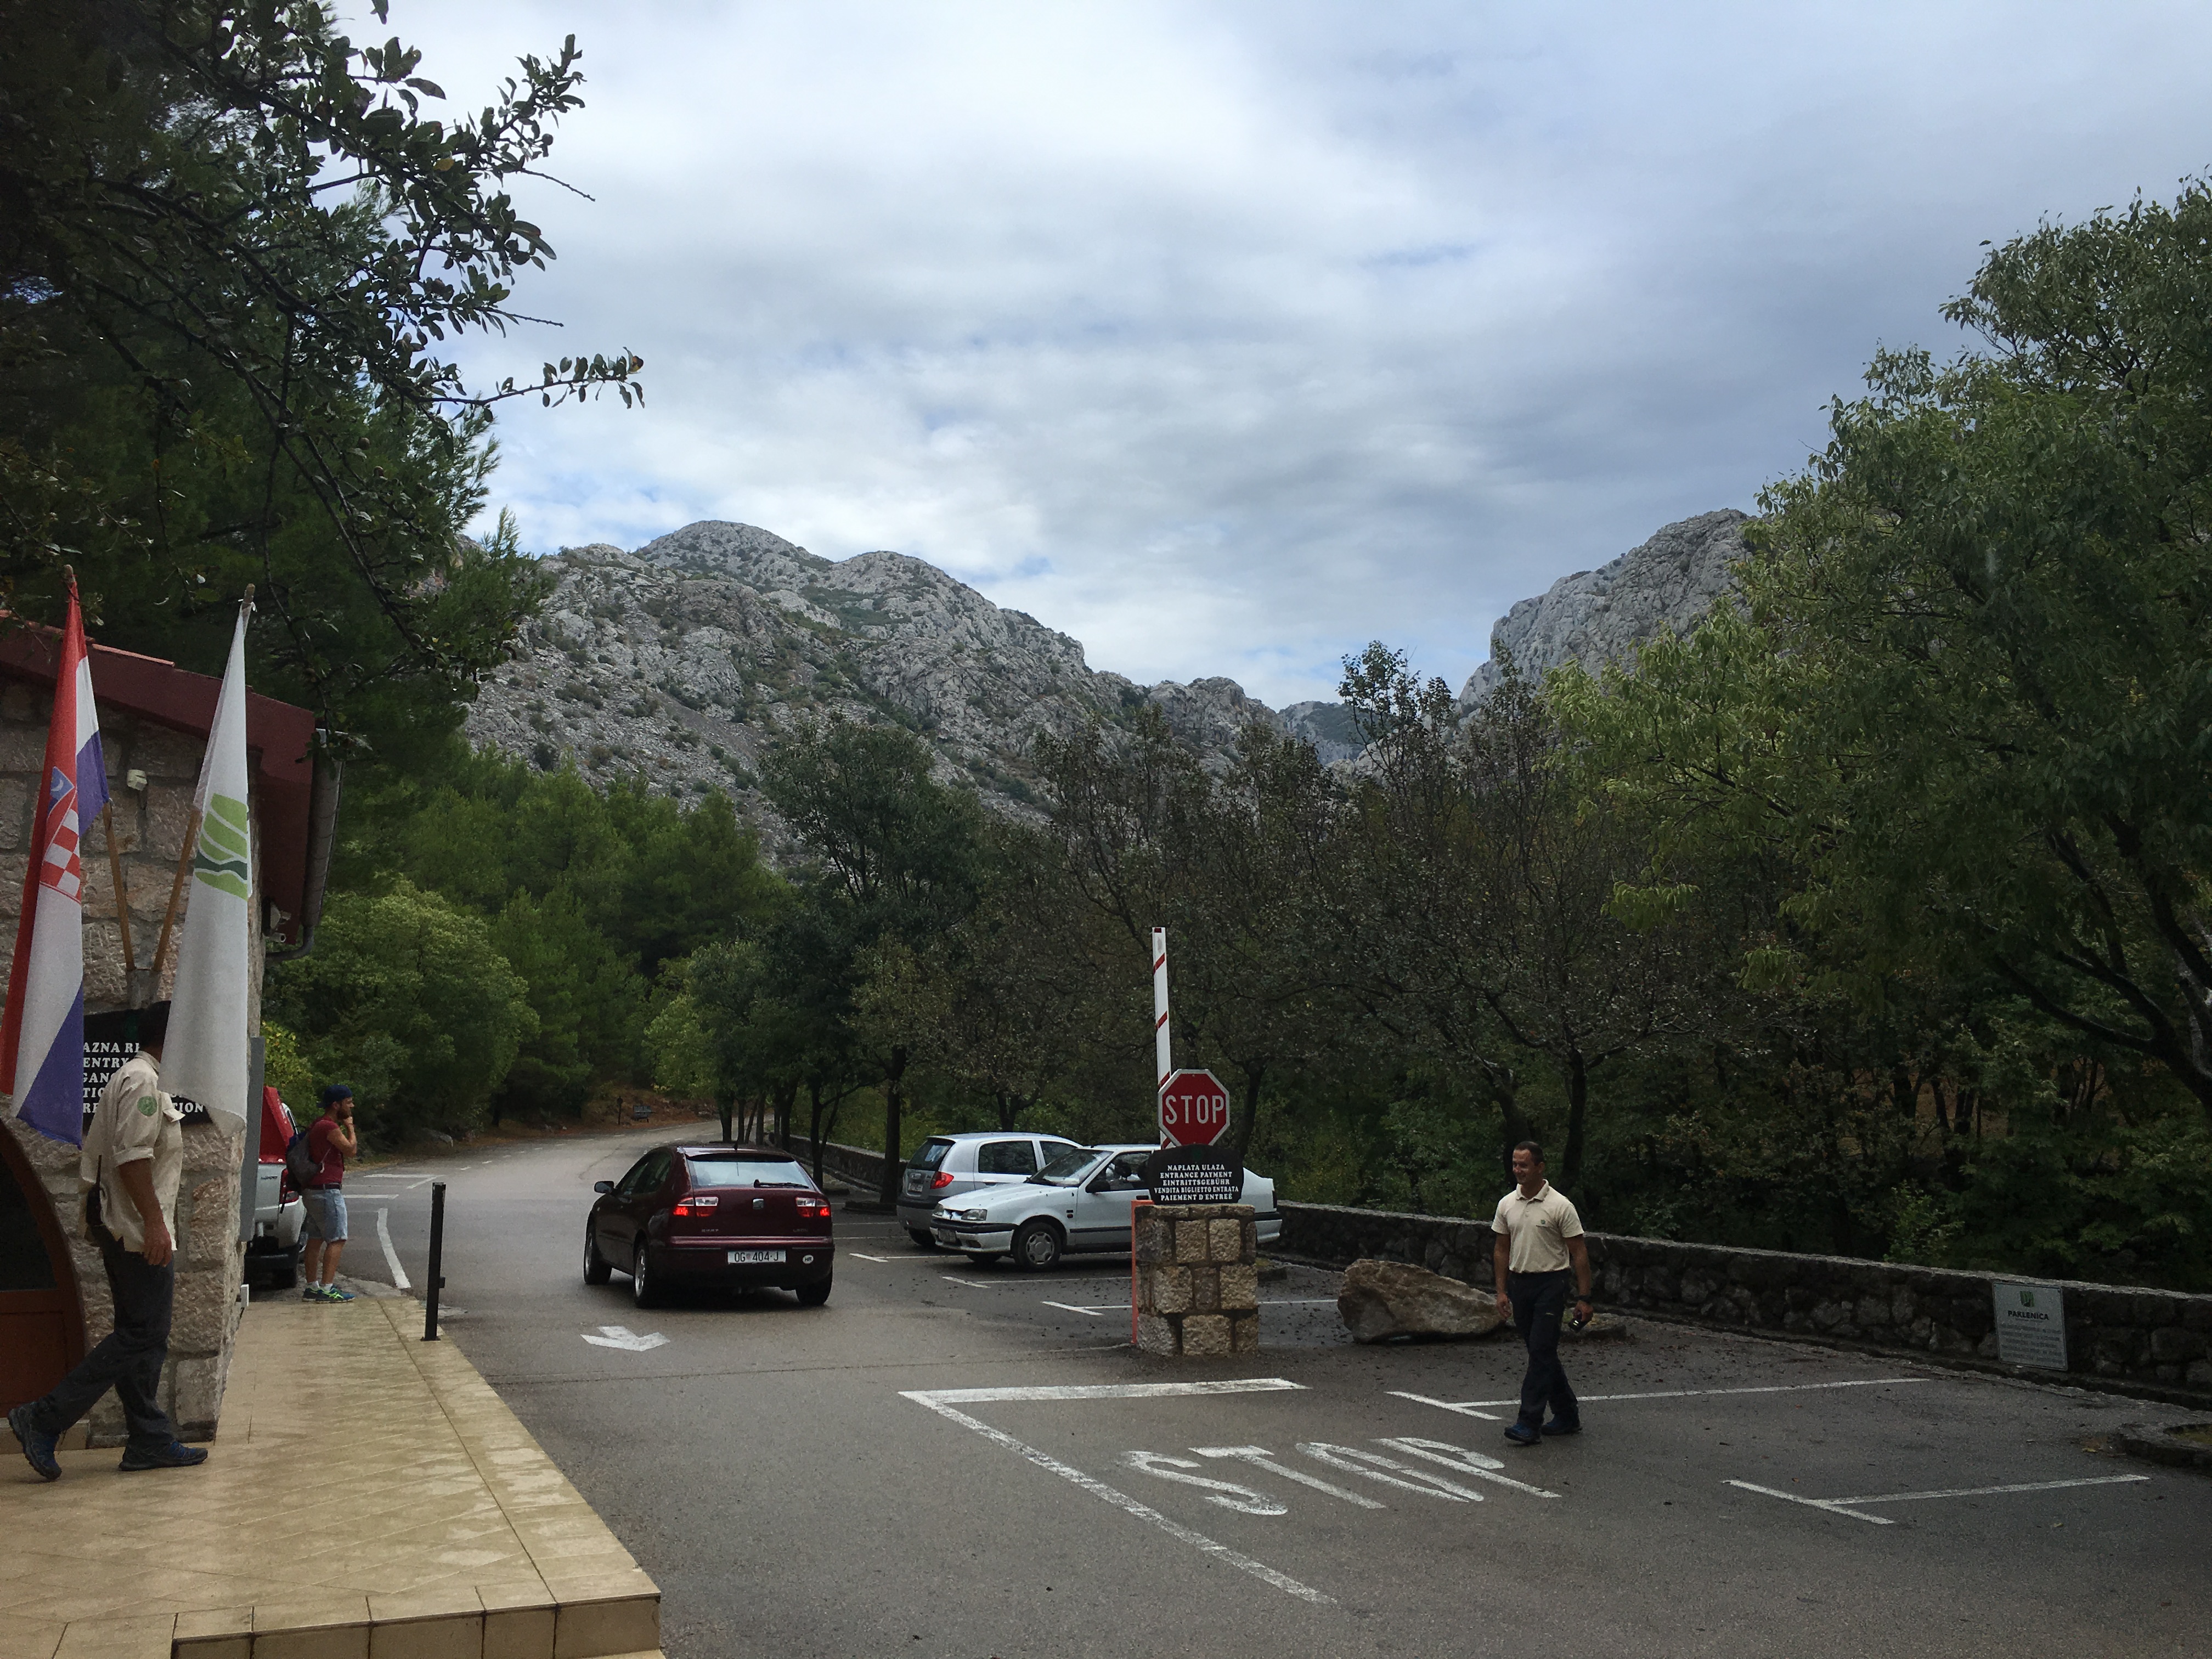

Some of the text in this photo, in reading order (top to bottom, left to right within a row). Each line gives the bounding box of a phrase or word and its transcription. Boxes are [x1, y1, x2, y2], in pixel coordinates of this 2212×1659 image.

[1165, 1095, 1224, 1124] STOP
[734, 1252, 746, 1262] OG
[2008, 1310, 2049, 1320] PAKLENICA
[1126, 1438, 1562, 1515] STOP
